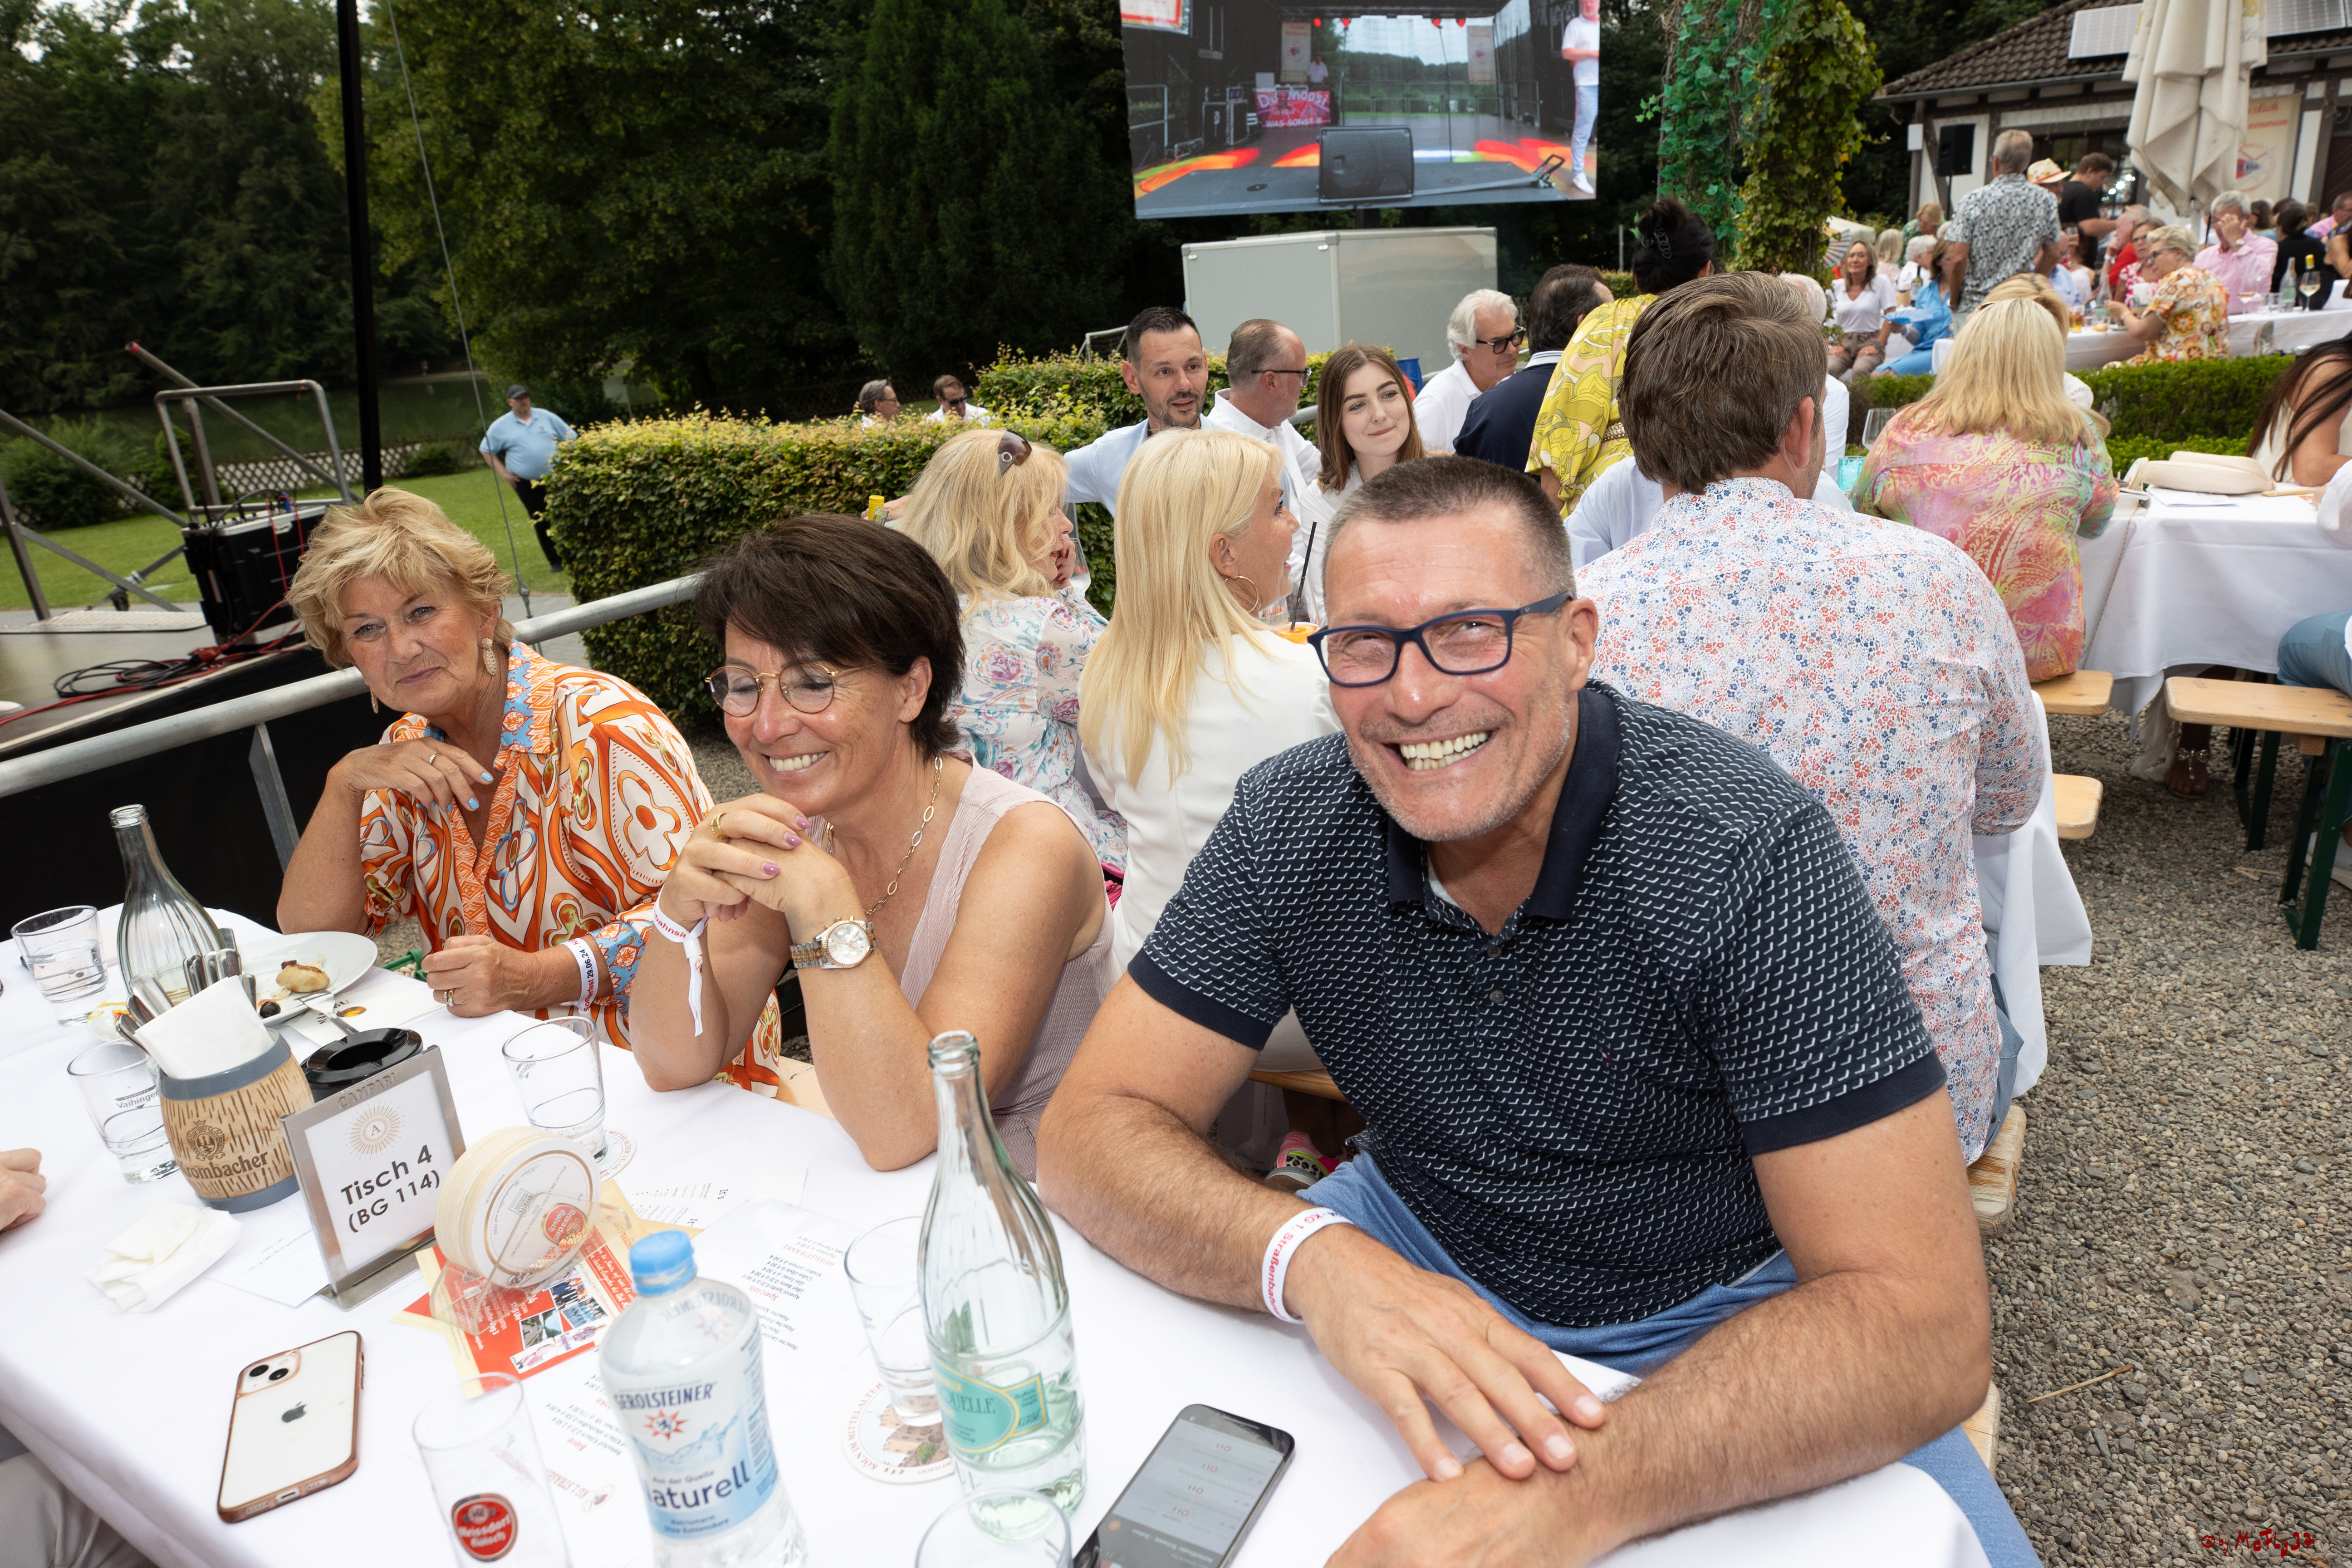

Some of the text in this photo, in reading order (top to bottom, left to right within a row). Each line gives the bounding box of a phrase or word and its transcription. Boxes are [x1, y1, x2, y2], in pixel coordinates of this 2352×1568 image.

[579, 949, 594, 979] 29.06.24
[116, 1090, 159, 1108] Vaihinger
[338, 1072, 397, 1109] CAMPARI
[371, 1124, 382, 1136] A
[608, 1129, 632, 1155] MITTELALTER
[184, 1151, 268, 1179] rombacher
[340, 1144, 432, 1205] Tisch 4
[349, 1170, 440, 1233] (BG 114)
[552, 1208, 577, 1242] Reissdorf
[782, 1245, 835, 1266] HEISSGETRÄNKE
[805, 1269, 821, 1277] Vodka
[749, 1286, 779, 1301] Specials
[783, 1291, 800, 1299] Aperol
[613, 1383, 713, 1411] GEROLSTEINER
[568, 1438, 587, 1451] Biere
